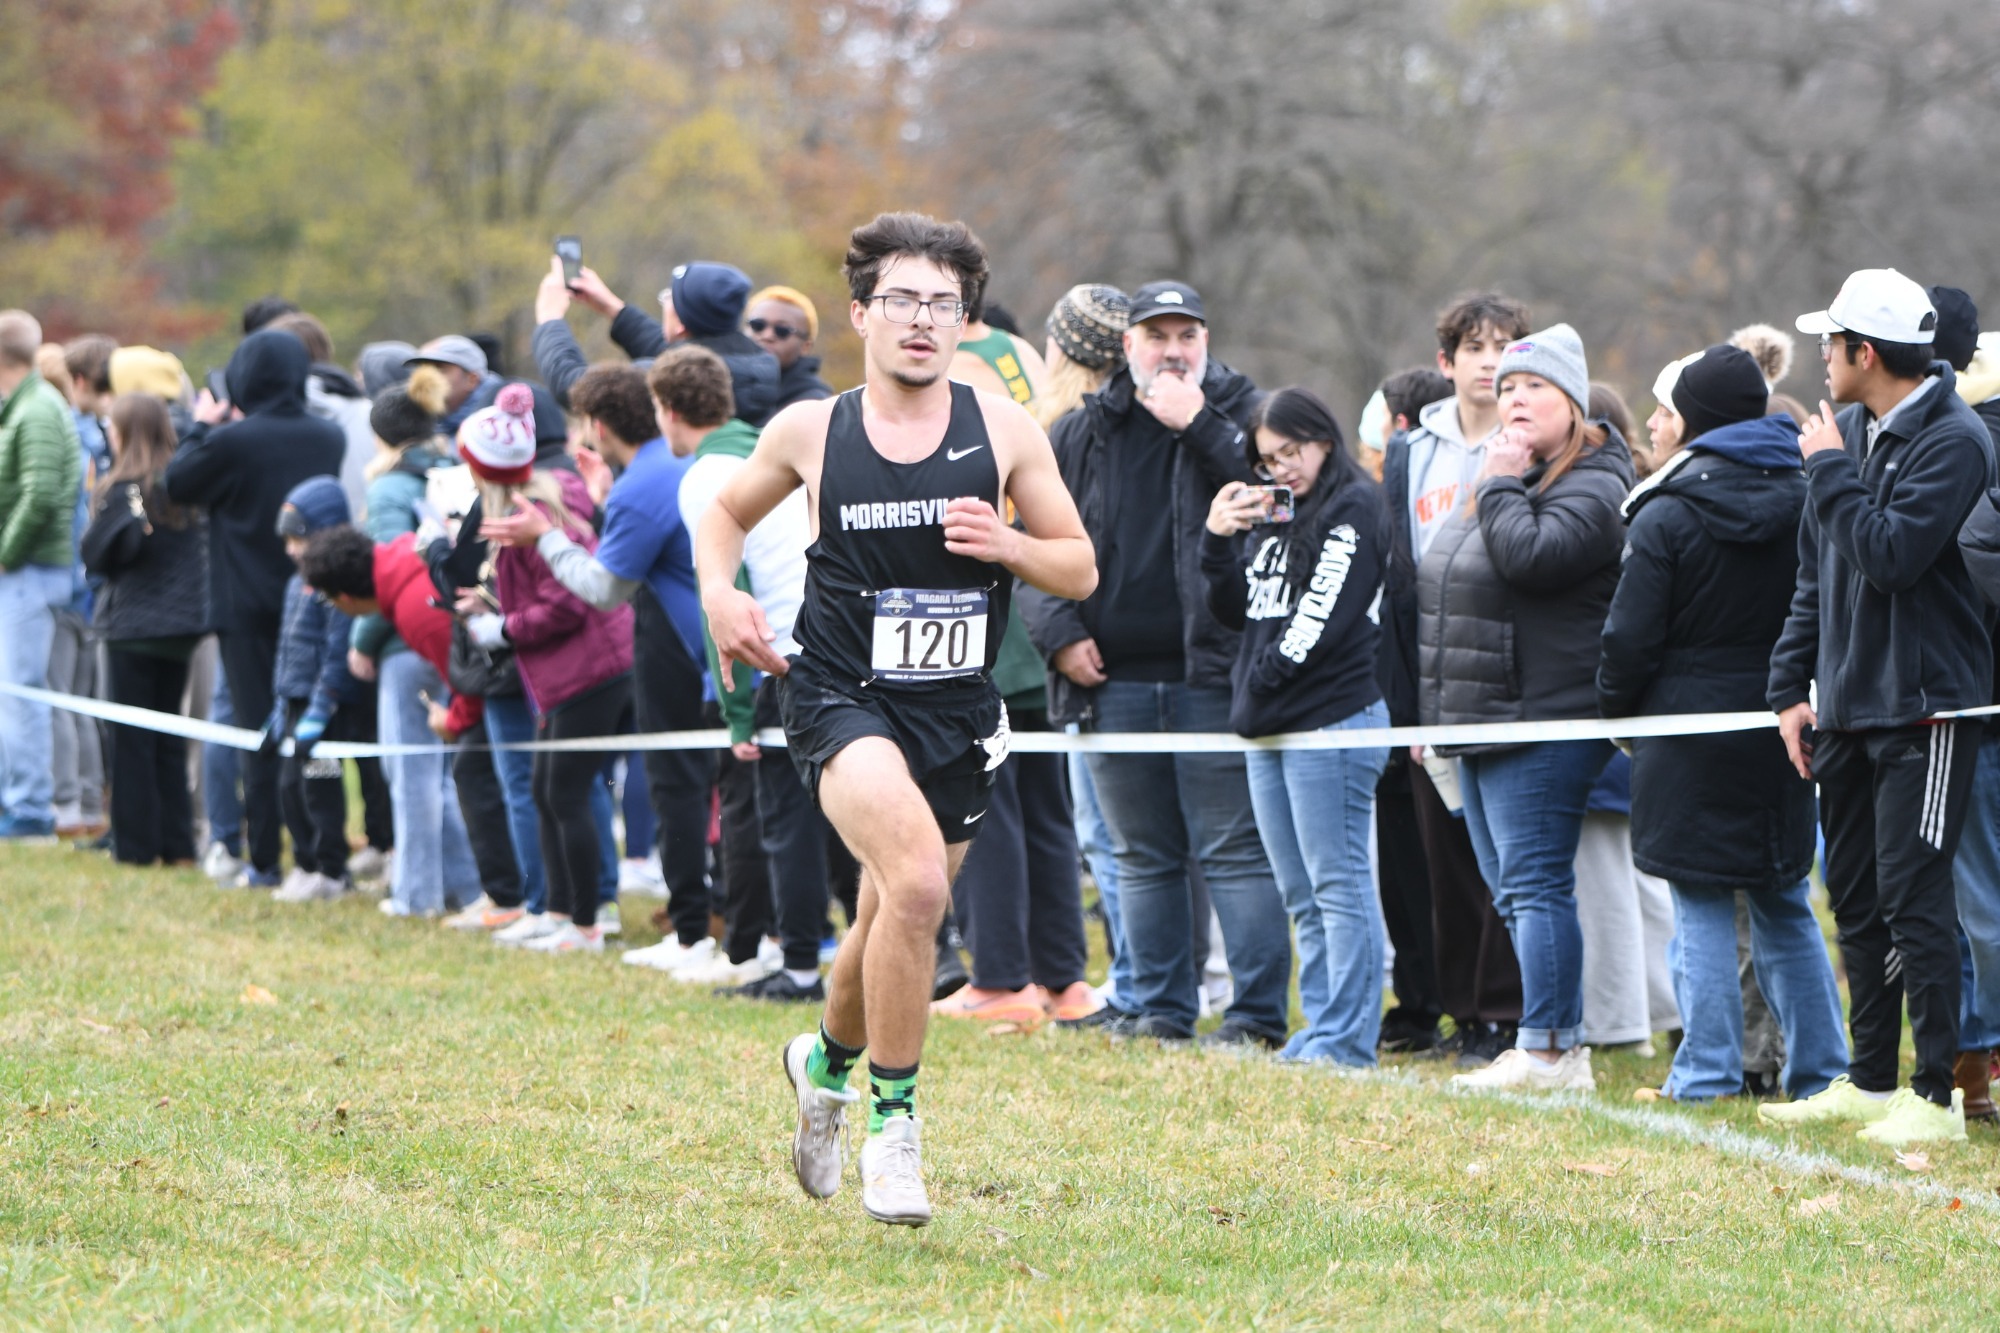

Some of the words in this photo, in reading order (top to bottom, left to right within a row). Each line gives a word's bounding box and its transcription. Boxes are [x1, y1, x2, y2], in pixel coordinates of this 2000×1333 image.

[916, 593, 950, 604] NIAGARA
[1279, 539, 1357, 664] MUSTANGS
[895, 620, 969, 669] 120
